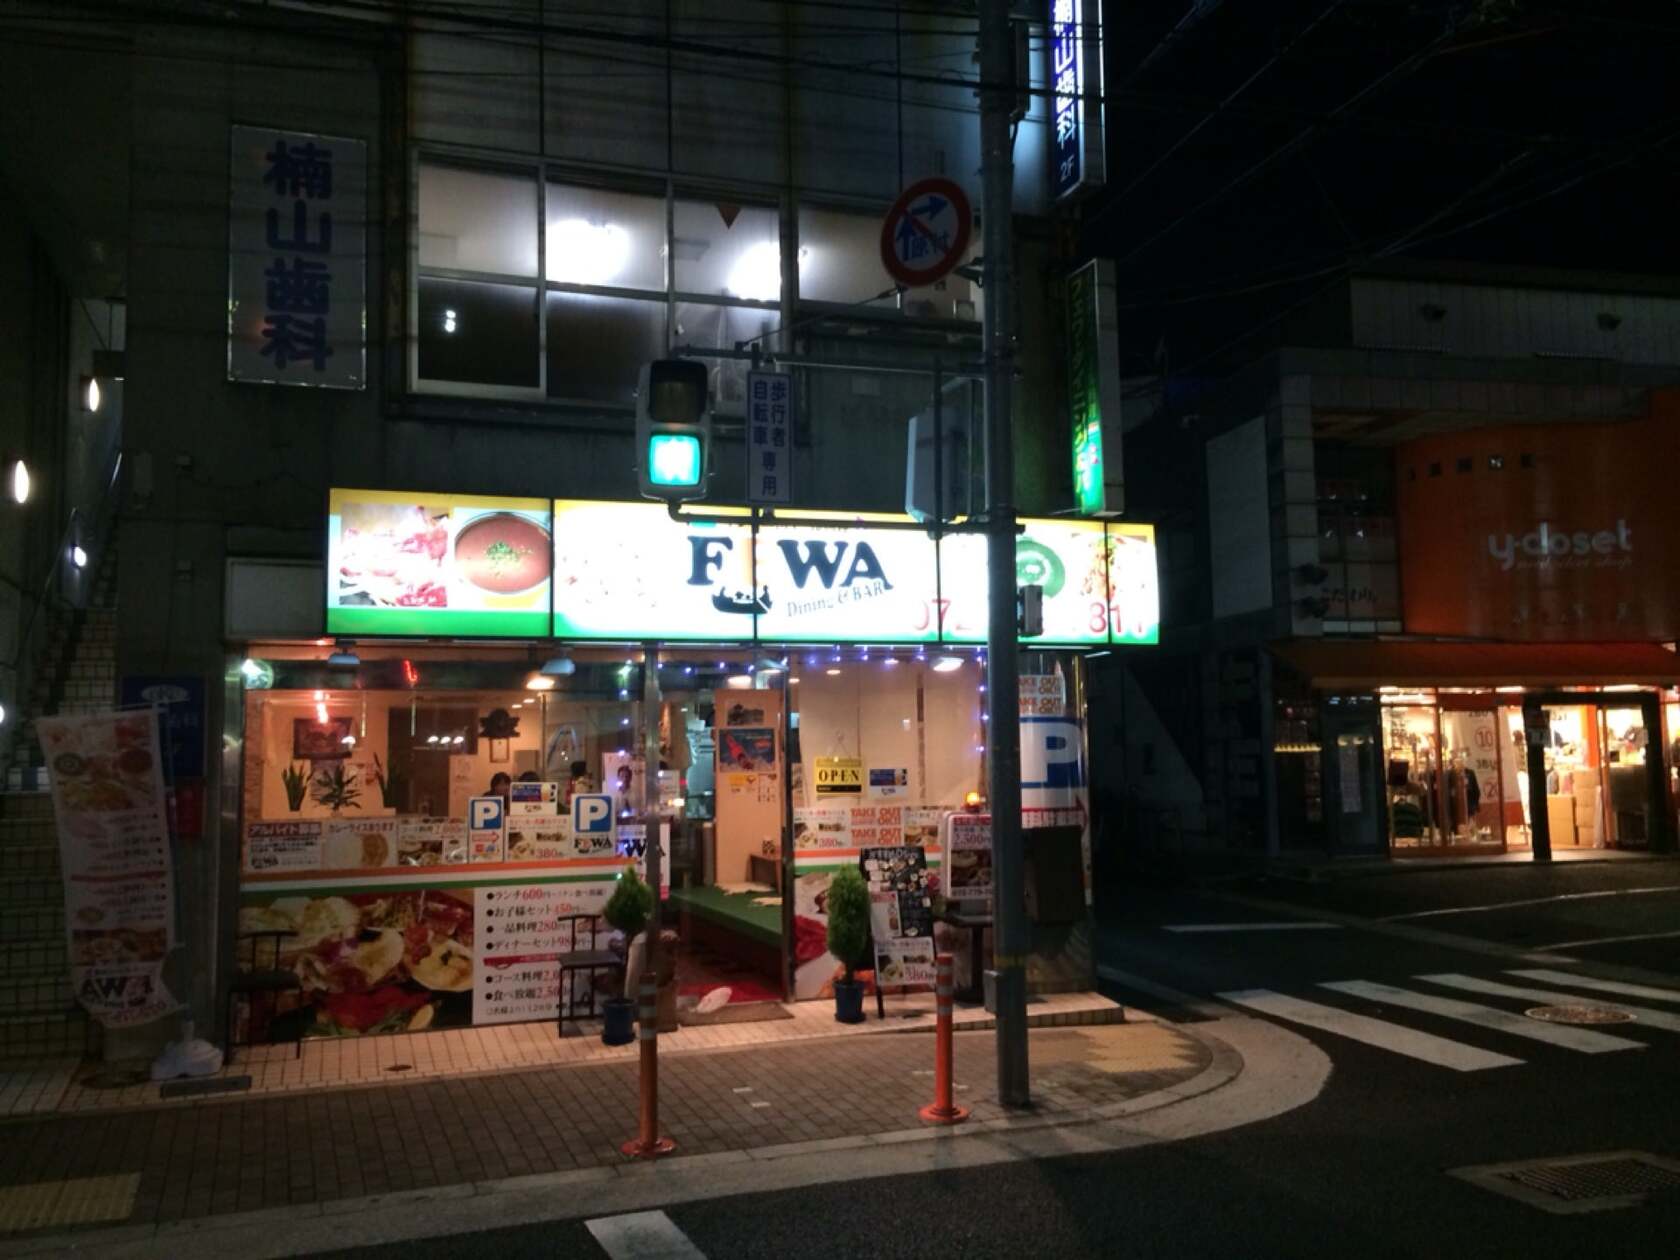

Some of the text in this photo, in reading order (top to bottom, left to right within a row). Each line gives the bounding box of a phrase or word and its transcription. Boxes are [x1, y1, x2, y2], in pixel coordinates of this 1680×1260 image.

[1060, 153, 1075, 184] 2F
[262, 138, 333, 372] 楠山歯科
[753, 380, 769, 446] 自転車
[771, 381, 787, 448] 歩行者
[762, 451, 777, 496] 専用
[818, 769, 860, 783] OPEN
[474, 800, 500, 829] P
[579, 799, 609, 832] P
[851, 808, 877, 817] TAKE
[879, 807, 901, 817] OUT
[851, 827, 901, 837] TAKE OUT
